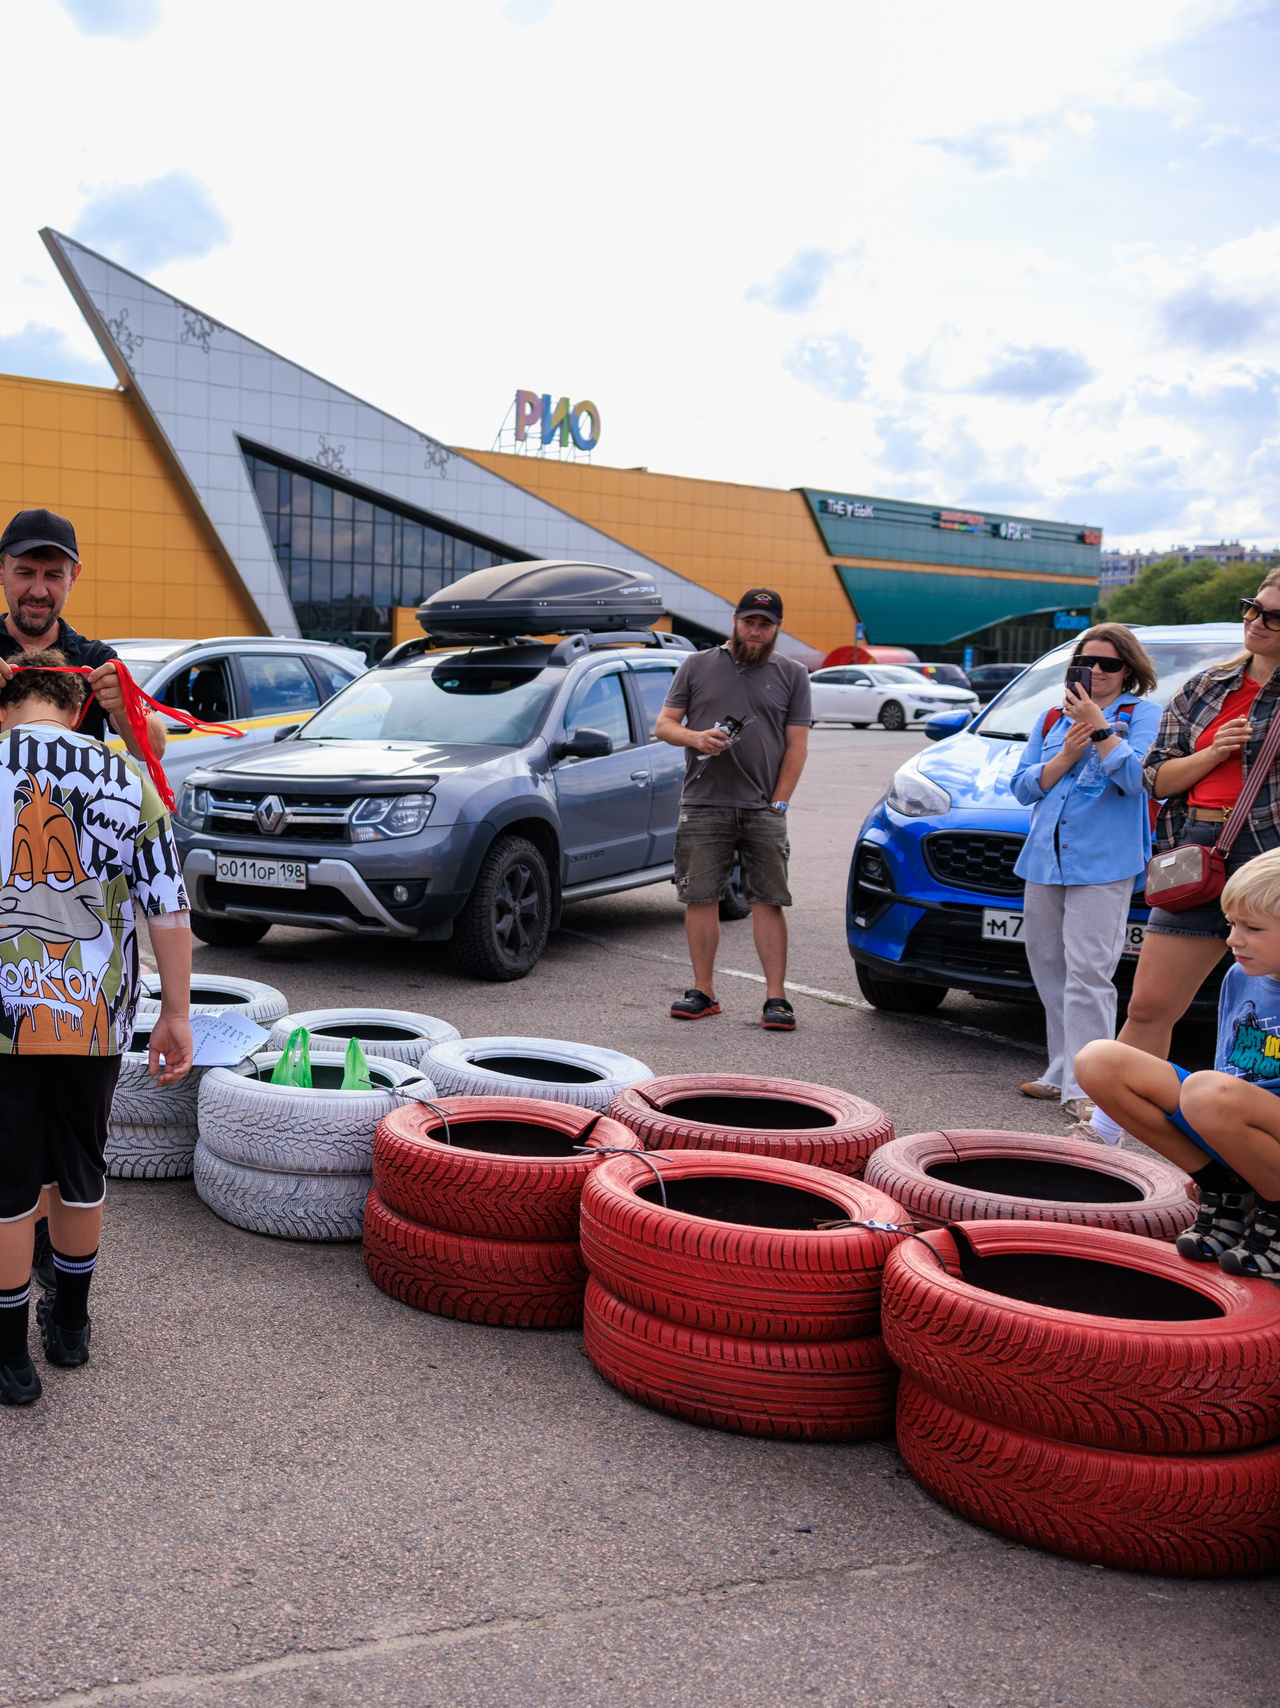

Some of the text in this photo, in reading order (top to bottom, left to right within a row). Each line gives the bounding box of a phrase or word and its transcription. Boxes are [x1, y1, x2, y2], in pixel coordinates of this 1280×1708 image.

[516, 389, 601, 451] РИО
[280, 864, 303, 878] 198
[63, 962, 111, 1006] ON
